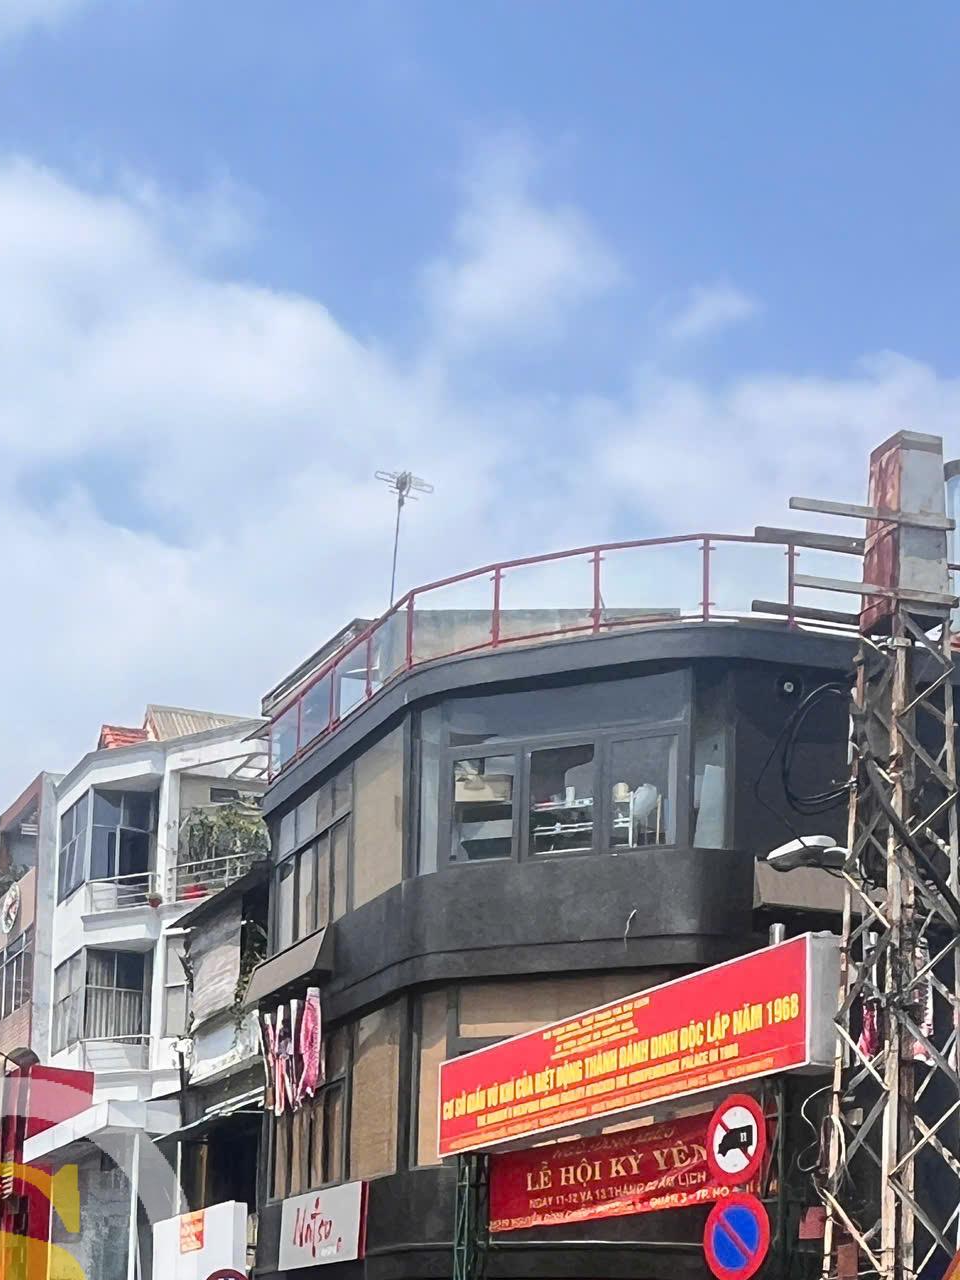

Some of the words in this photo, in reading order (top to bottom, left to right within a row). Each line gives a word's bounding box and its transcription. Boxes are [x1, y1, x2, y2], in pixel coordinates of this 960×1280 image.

[733, 1003, 762, 1035] NĂM
[766, 993, 799, 1025] 1968
[560, 1158, 602, 1187] HỘI
